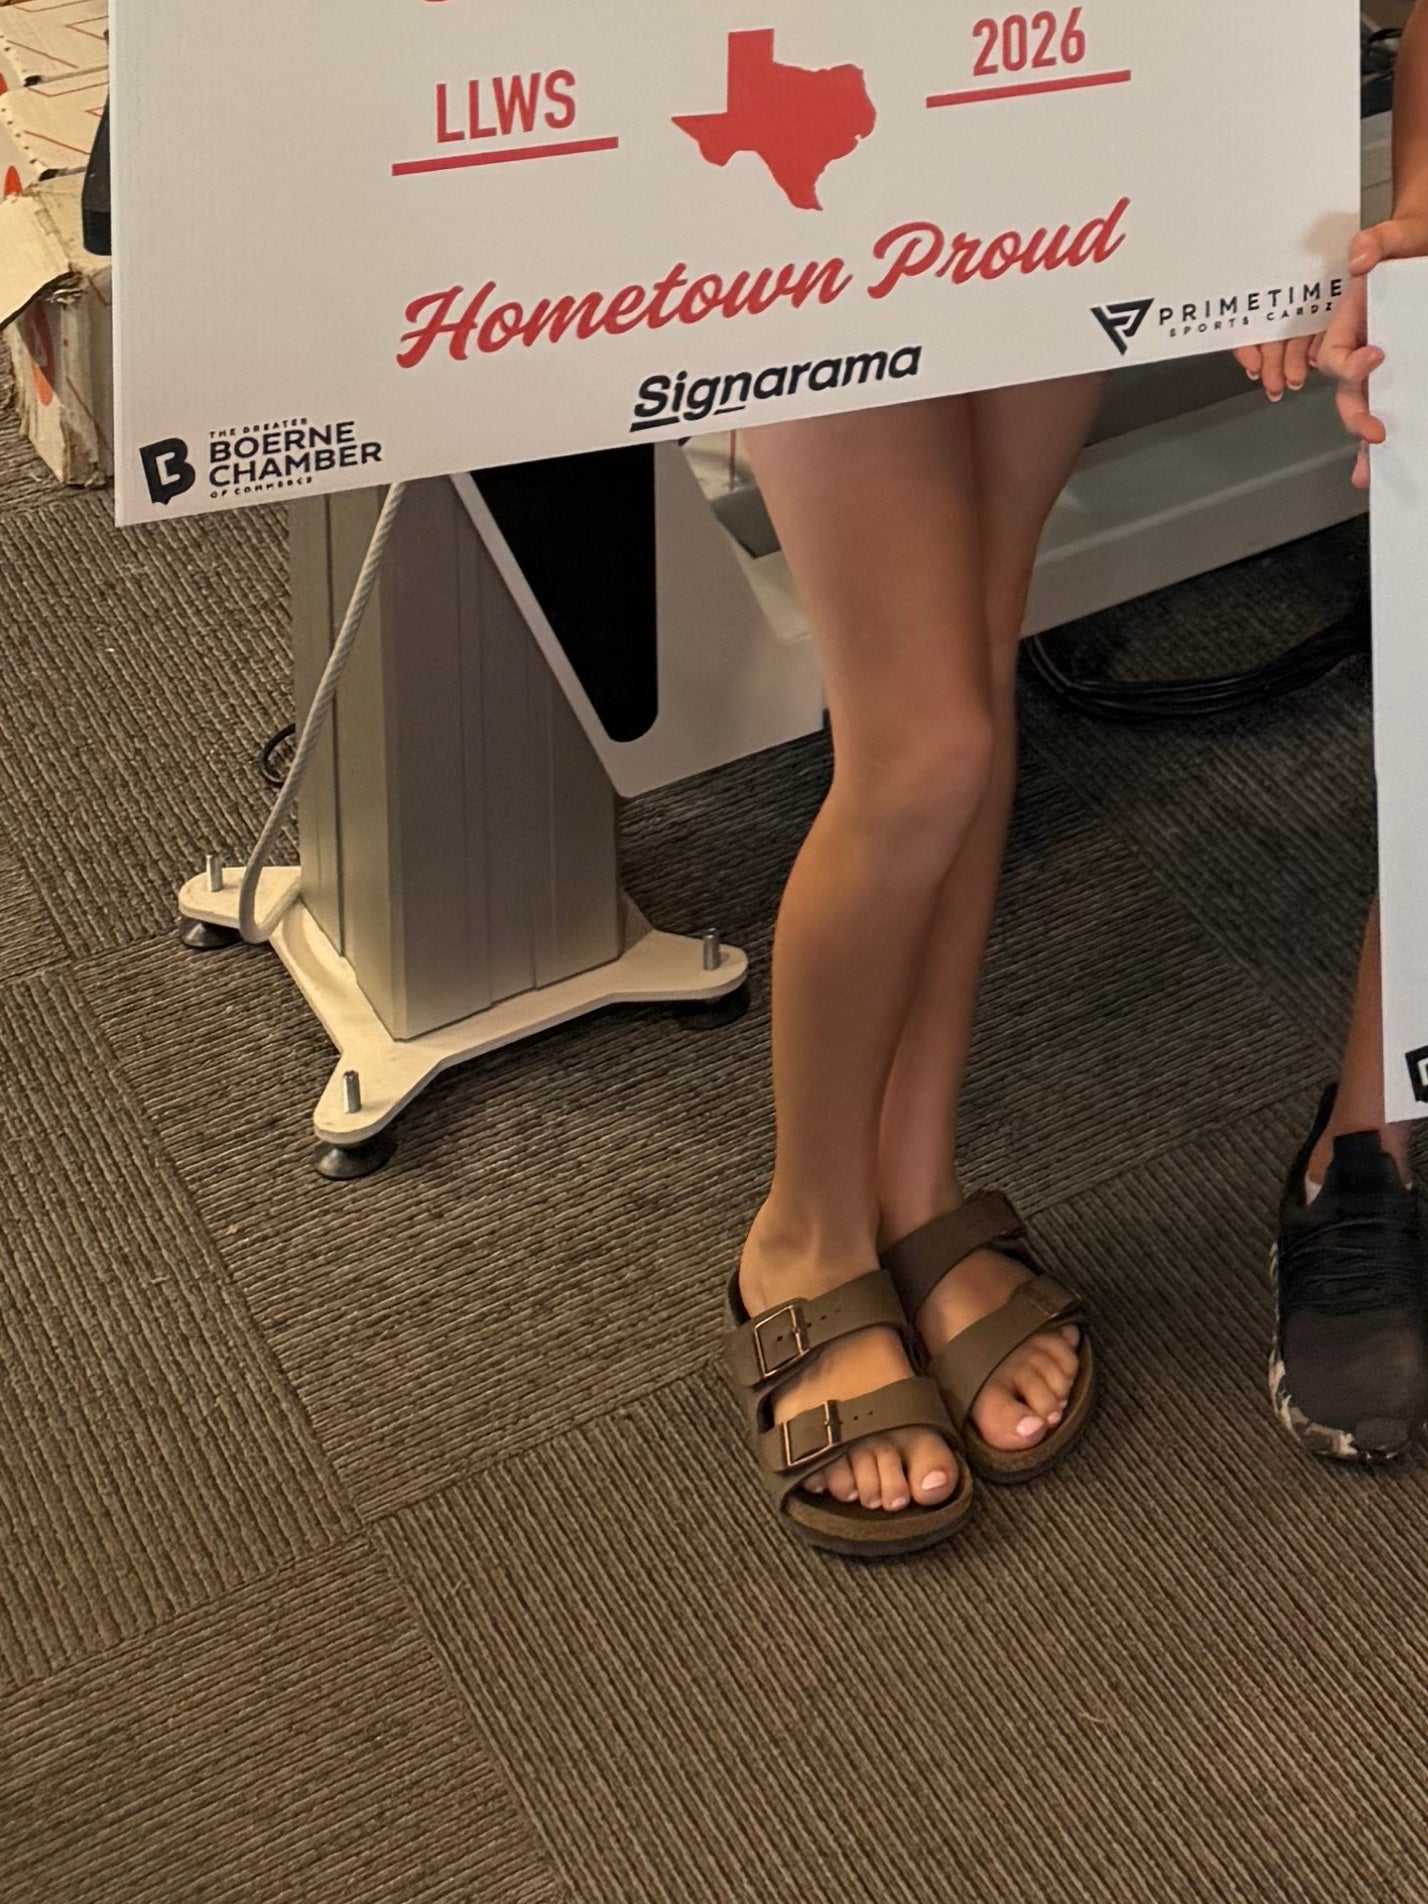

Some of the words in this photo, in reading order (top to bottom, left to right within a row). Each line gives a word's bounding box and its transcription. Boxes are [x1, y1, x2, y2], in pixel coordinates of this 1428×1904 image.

[971, 4, 1087, 78] 2026
[434, 66, 577, 146] LLWS
[396, 258, 851, 368] Hometown
[868, 198, 1129, 299] Proud
[1159, 279, 1342, 325] PRIMETIME
[1170, 317, 1249, 337] SPORTS
[1267, 303, 1333, 321] CARDZ
[632, 345, 922, 422] Signarama
[210, 428, 236, 439] THE
[210, 421, 355, 463] BOERNE
[209, 442, 382, 487] CHAMBER
